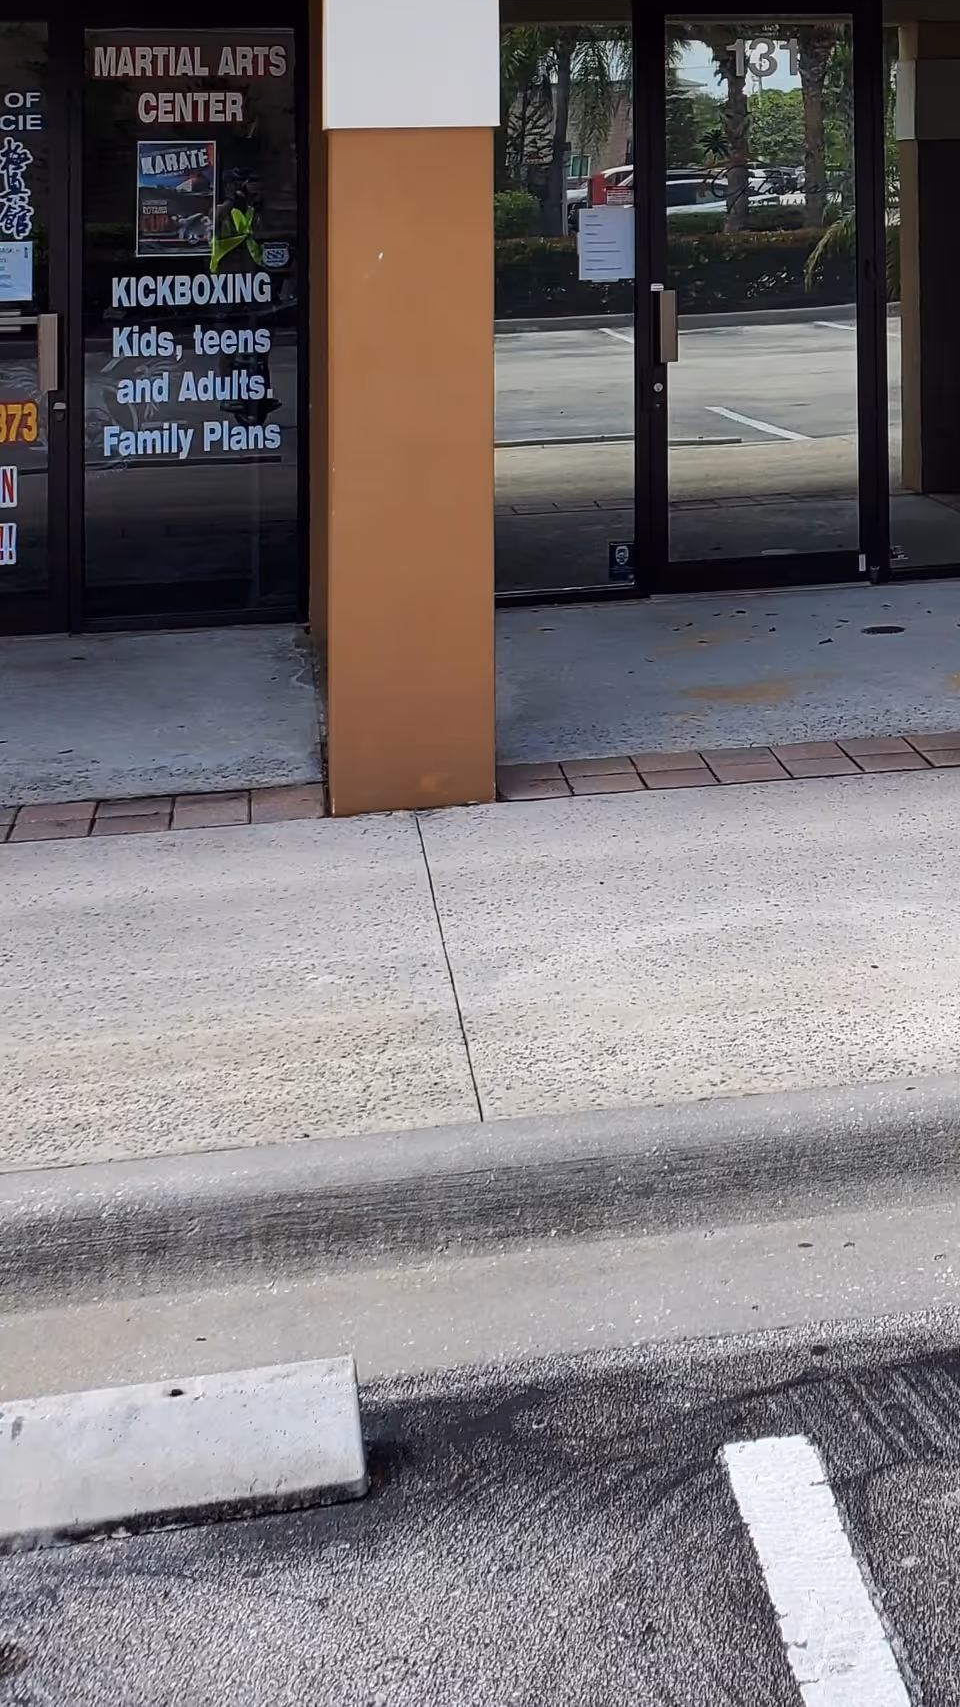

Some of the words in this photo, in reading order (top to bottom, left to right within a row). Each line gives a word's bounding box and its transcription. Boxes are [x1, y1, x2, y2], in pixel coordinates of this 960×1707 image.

[94, 46, 208, 77] MARTIAL
[218, 45, 287, 76] ARTS
[726, 37, 798, 77] 131
[4, 93, 41, 108] OF
[138, 92, 244, 123] CENTER
[141, 148, 209, 175] KARATE
[111, 272, 271, 307] KICKBOXING
[112, 326, 183, 361] Kids,
[193, 325, 271, 355] teens
[116, 372, 169, 404] and
[103, 423, 194, 460] Family
[203, 421, 281, 452] Plans
